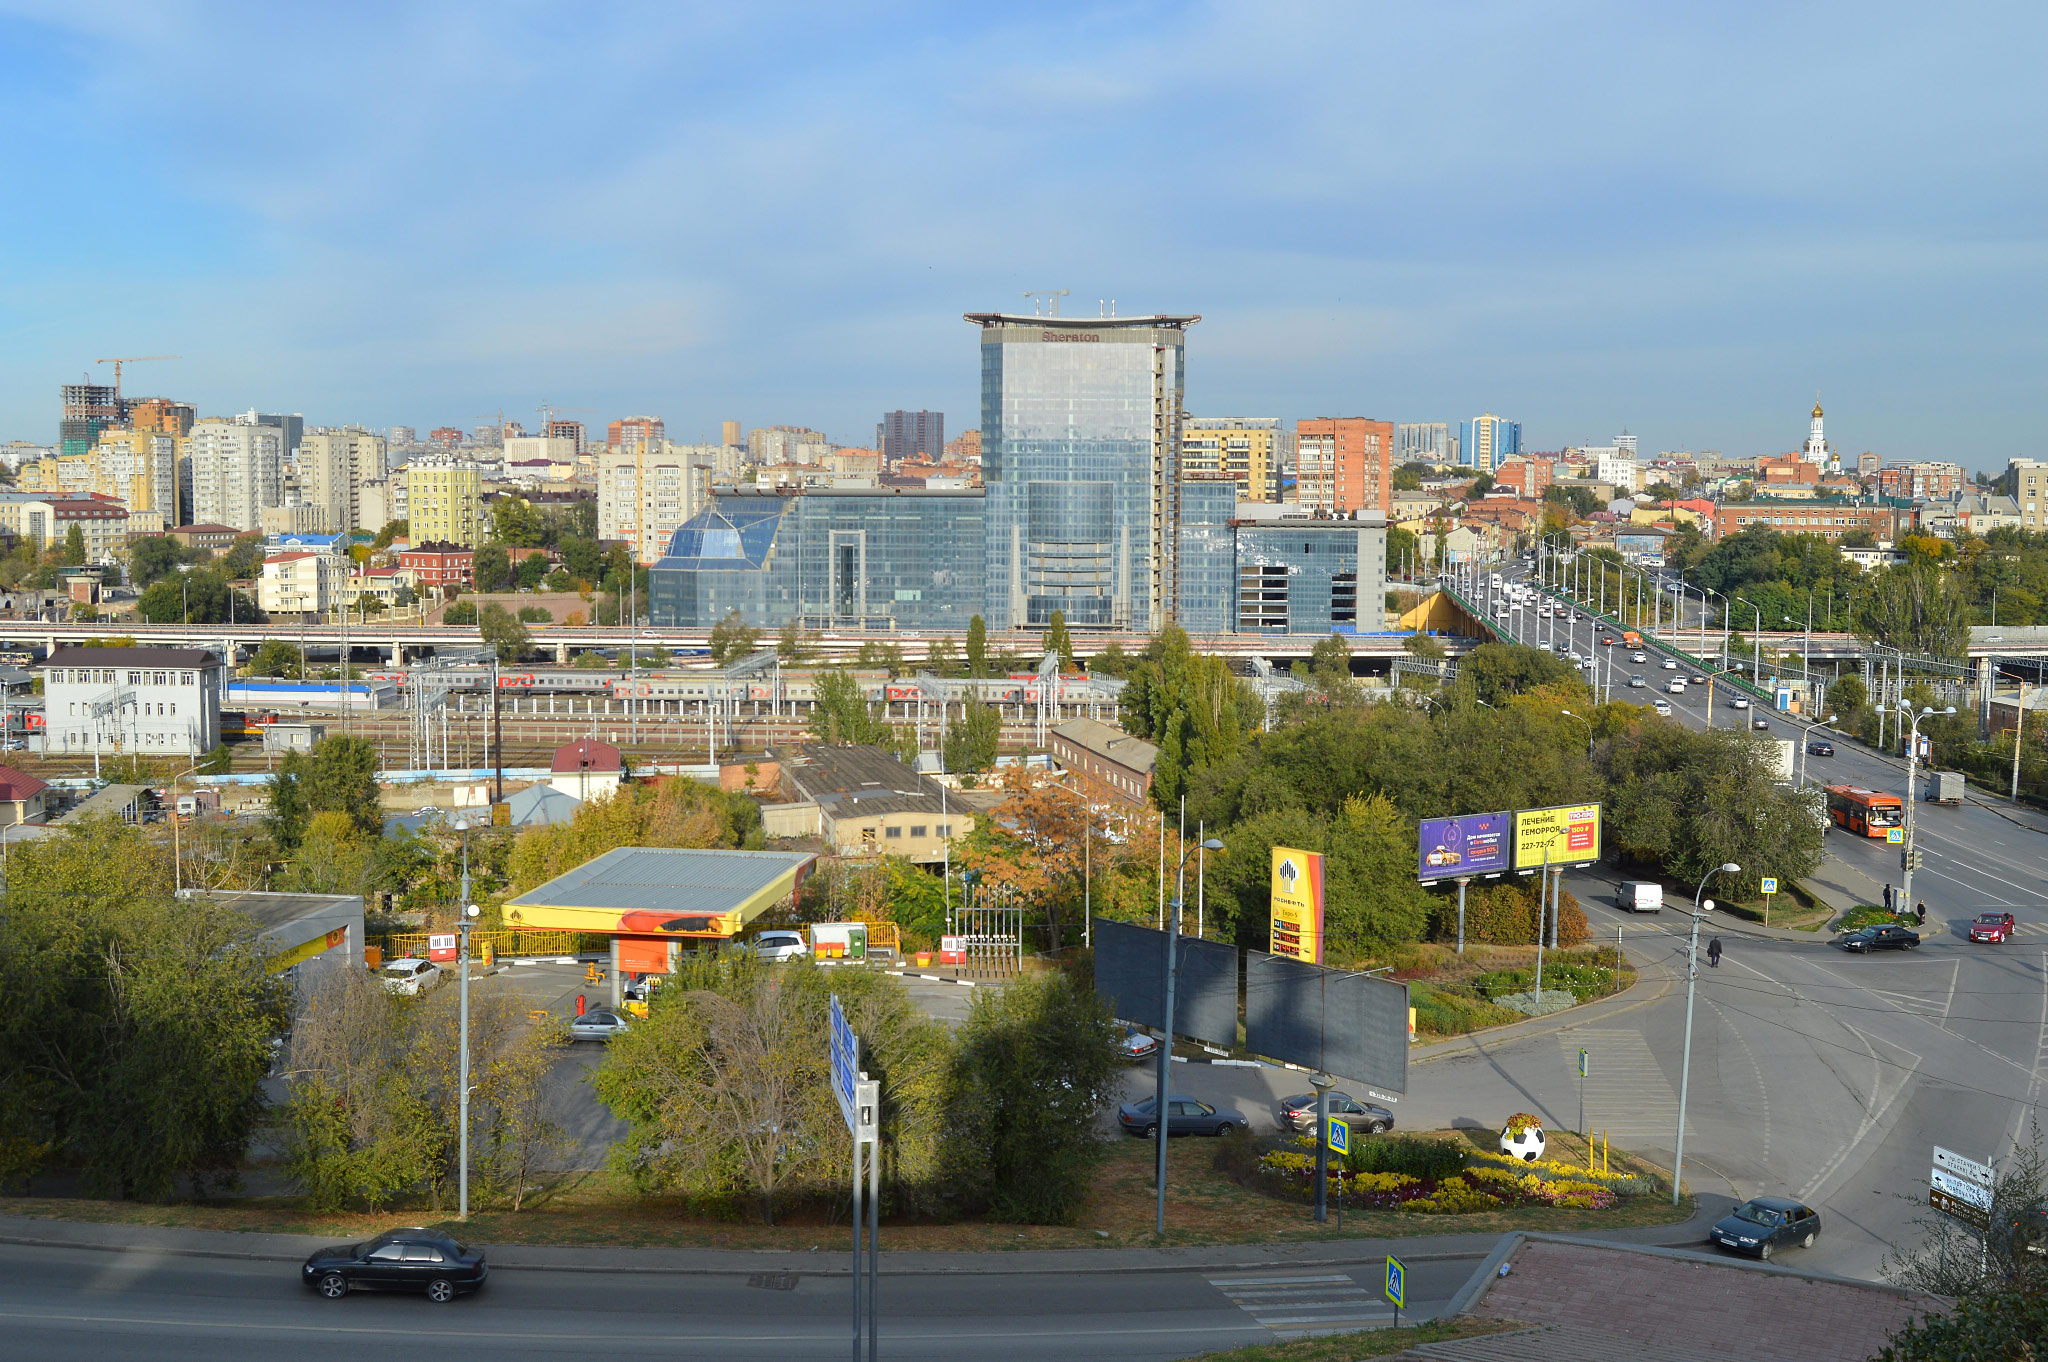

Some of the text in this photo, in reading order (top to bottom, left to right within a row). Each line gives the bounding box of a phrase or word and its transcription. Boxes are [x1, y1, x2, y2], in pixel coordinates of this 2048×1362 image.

[1042, 331, 1099, 342] Sheraton
[1521, 815, 1555, 826] ЛЕЧЕНИЕ
[1521, 825, 1561, 836] ГЕМОРРОЯ
[1521, 840, 1555, 850] 227-72-72
[1274, 897, 1305, 908] РОСНЕФТЬ
